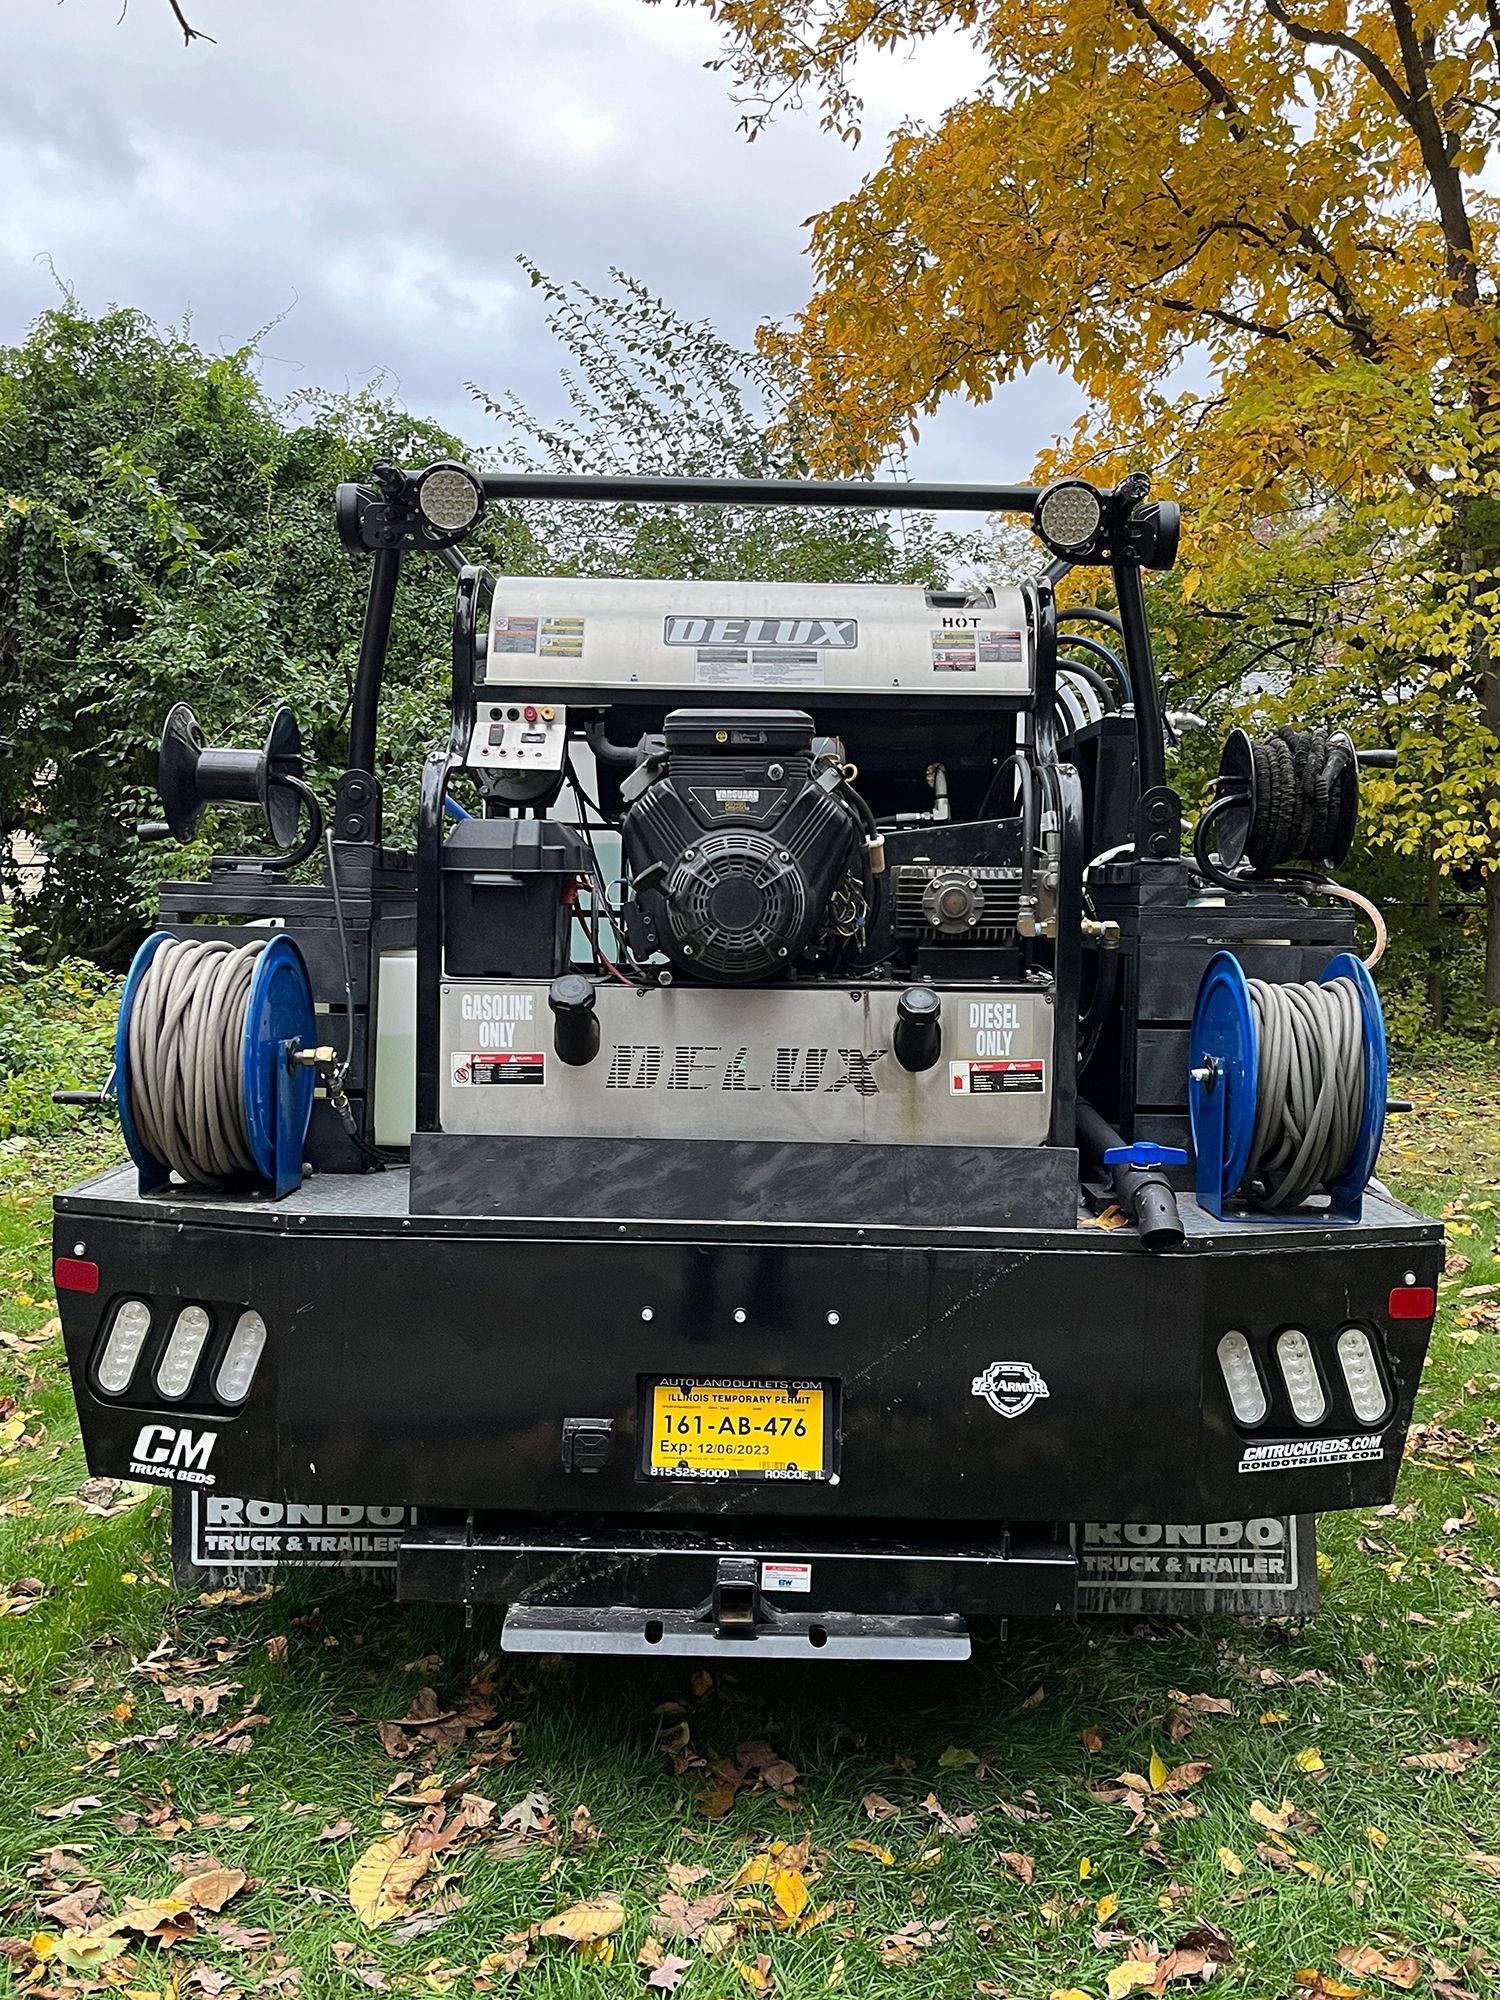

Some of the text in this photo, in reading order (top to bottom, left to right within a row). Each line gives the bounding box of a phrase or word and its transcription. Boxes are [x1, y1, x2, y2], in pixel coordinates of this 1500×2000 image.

[668, 618, 852, 646] DELUX
[942, 617, 981, 628] HOT
[715, 789, 760, 803] VANGUARD
[461, 993, 533, 1021] GASOLINE
[969, 1003, 1020, 1029] DIESEL
[479, 1021, 515, 1048] ONLY
[976, 1030, 1013, 1057] ONLY
[605, 1044, 889, 1096] DELUX
[668, 1393, 811, 1405] ILLINOIS TEMPORARY PERMIT
[664, 1414, 807, 1437] 161-AB-476
[132, 1424, 218, 1470] CM
[660, 1439, 770, 1456] Exp: 12/06/2023
[1241, 1450, 1381, 1470] RONDOTRAILER.COM
[129, 1461, 216, 1486] TRUCK BEDS
[650, 1467, 826, 1480] 815-525-5000 ROSCOE, IL
[206, 1496, 405, 1526] RONDO
[204, 1535, 402, 1552] TRUCK & TRAILER
[1083, 1556, 1285, 1574] TRUCK & TRAILER
